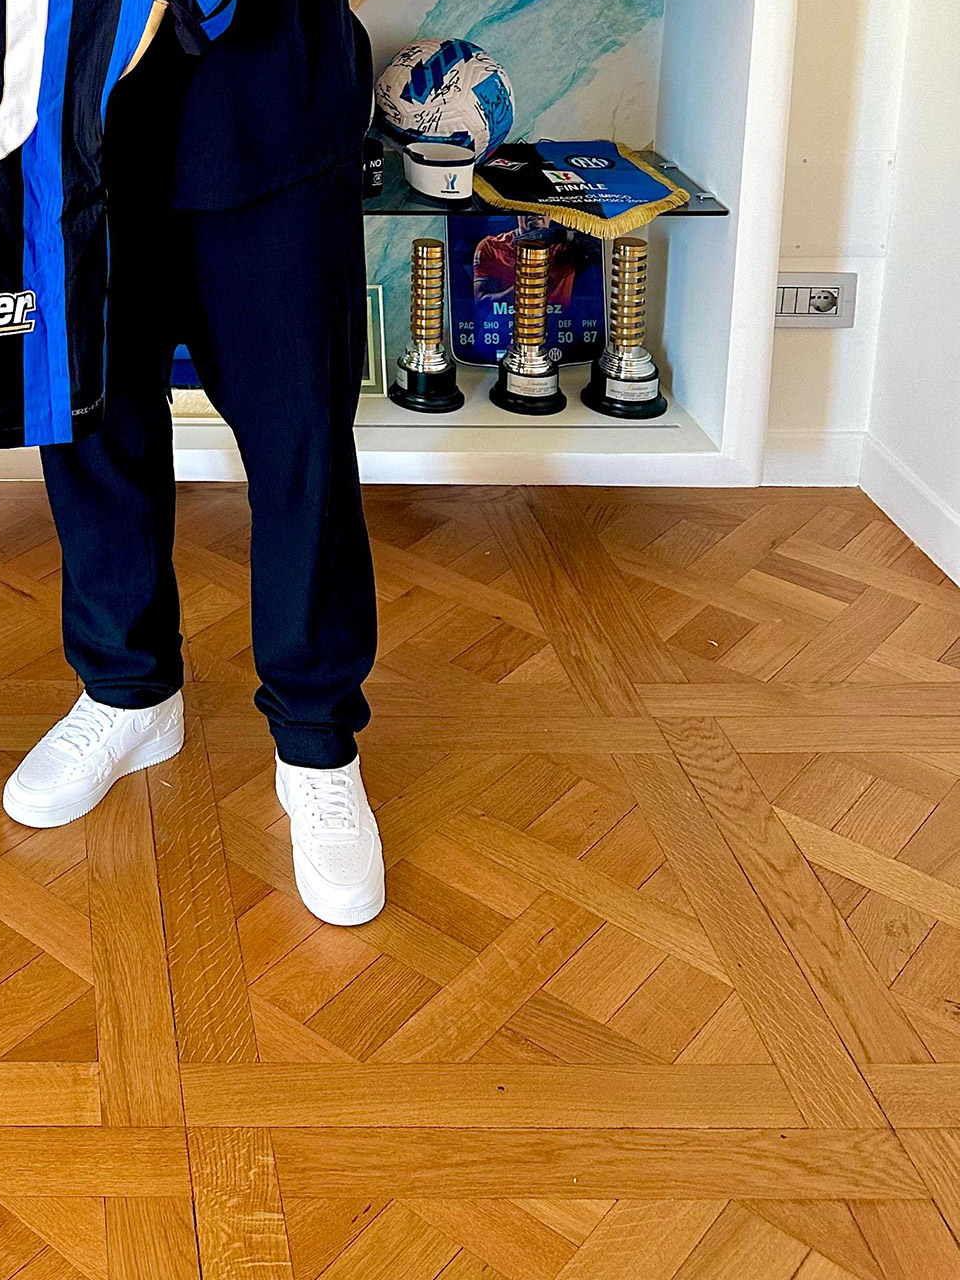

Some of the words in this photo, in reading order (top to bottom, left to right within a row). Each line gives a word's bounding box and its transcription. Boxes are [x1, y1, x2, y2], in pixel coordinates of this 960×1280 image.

[555, 183, 608, 193] FINALE
[493, 302, 563, 315] Maez
[459, 321, 475, 330] PAC
[483, 321, 499, 330] SHO
[558, 320, 572, 328] DEF
[582, 319, 597, 328] PHY
[459, 333, 475, 345] 84
[484, 333, 500, 345] 89
[557, 331, 573, 344] 50
[583, 331, 598, 343] 87
